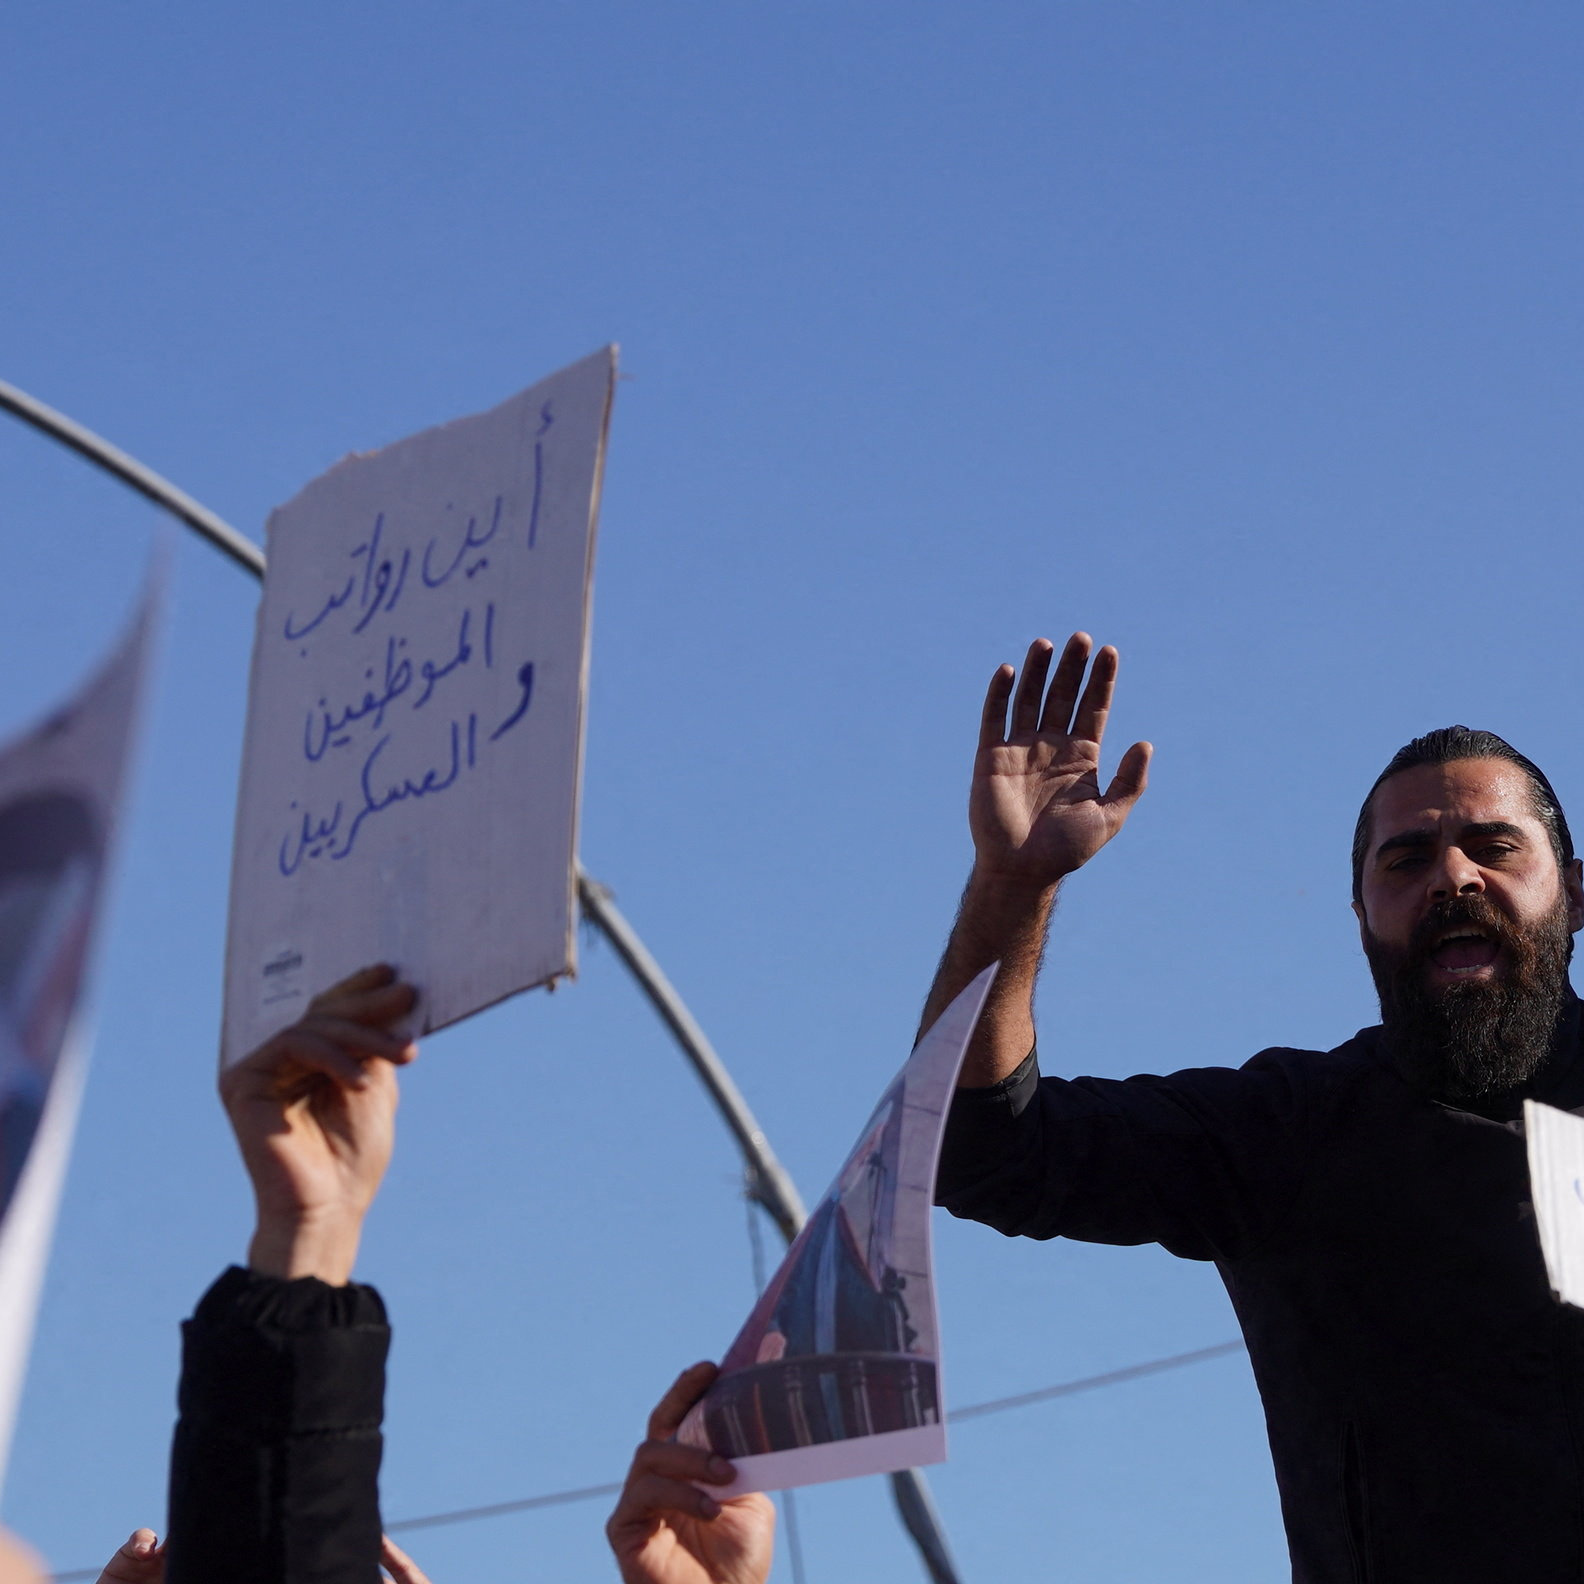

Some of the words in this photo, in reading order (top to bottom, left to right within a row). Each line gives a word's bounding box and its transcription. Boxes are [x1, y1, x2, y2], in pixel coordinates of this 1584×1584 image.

[421, 400, 553, 588] أين
[283, 511, 411, 659] رواتب
[303, 601, 494, 763] الموظفين
[488, 659, 535, 742] و
[278, 710, 478, 878] العسكريين
